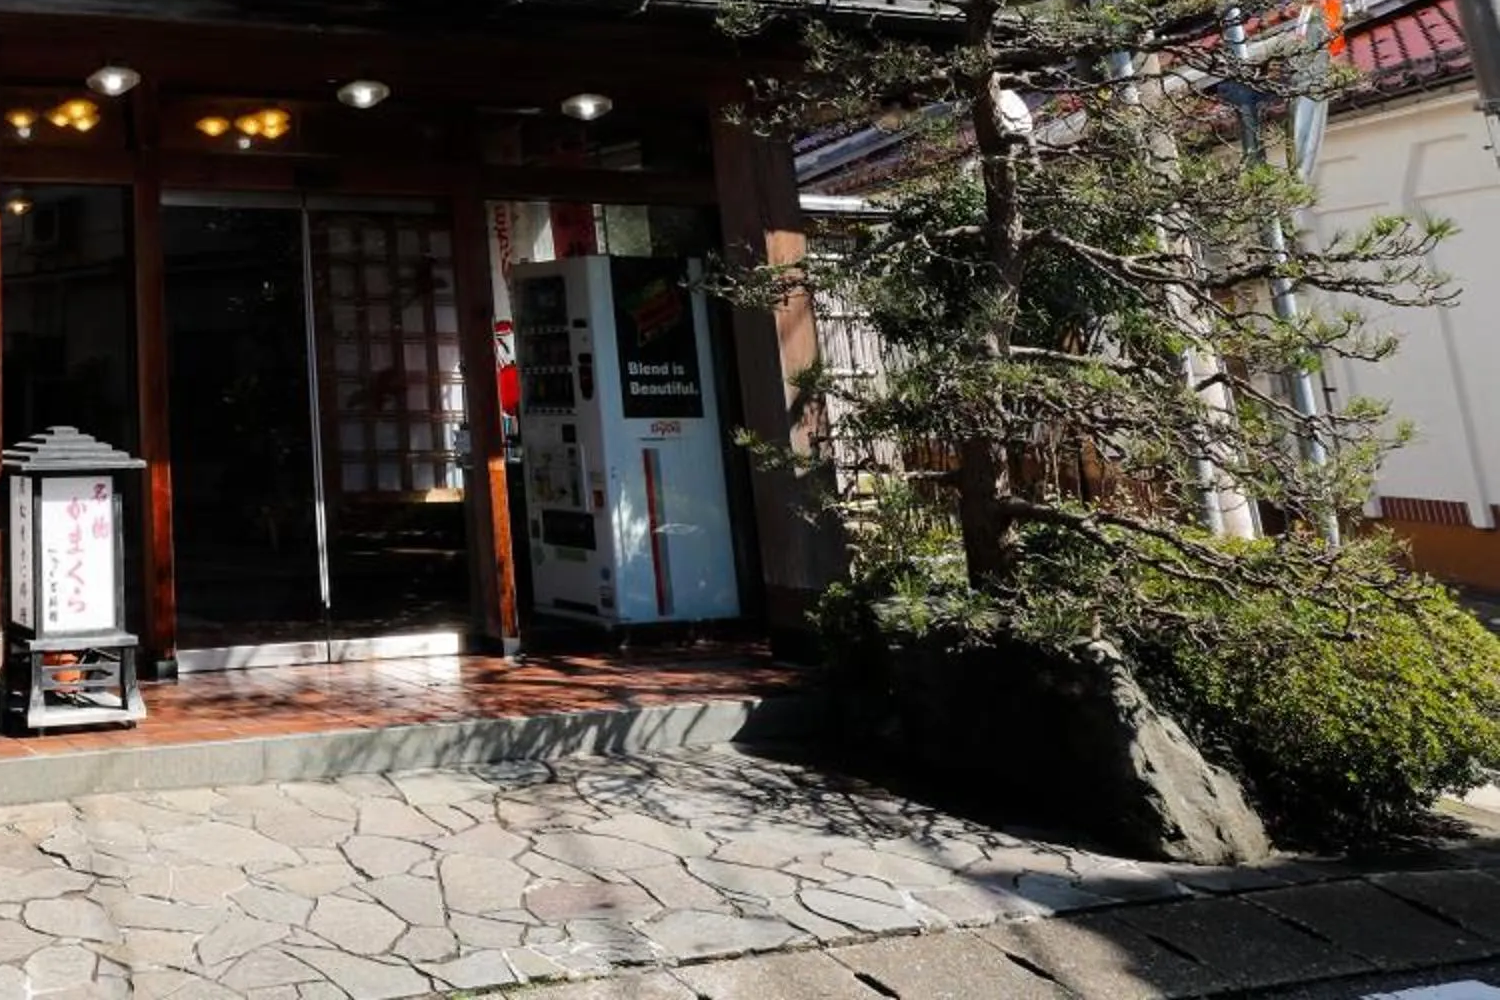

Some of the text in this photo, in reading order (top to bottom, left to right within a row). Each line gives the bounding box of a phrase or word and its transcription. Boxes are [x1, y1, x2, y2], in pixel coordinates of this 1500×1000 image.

[628, 361, 685, 376] Blend is
[630, 381, 699, 396] Beautiful.
[67, 496, 86, 613] かまくら
